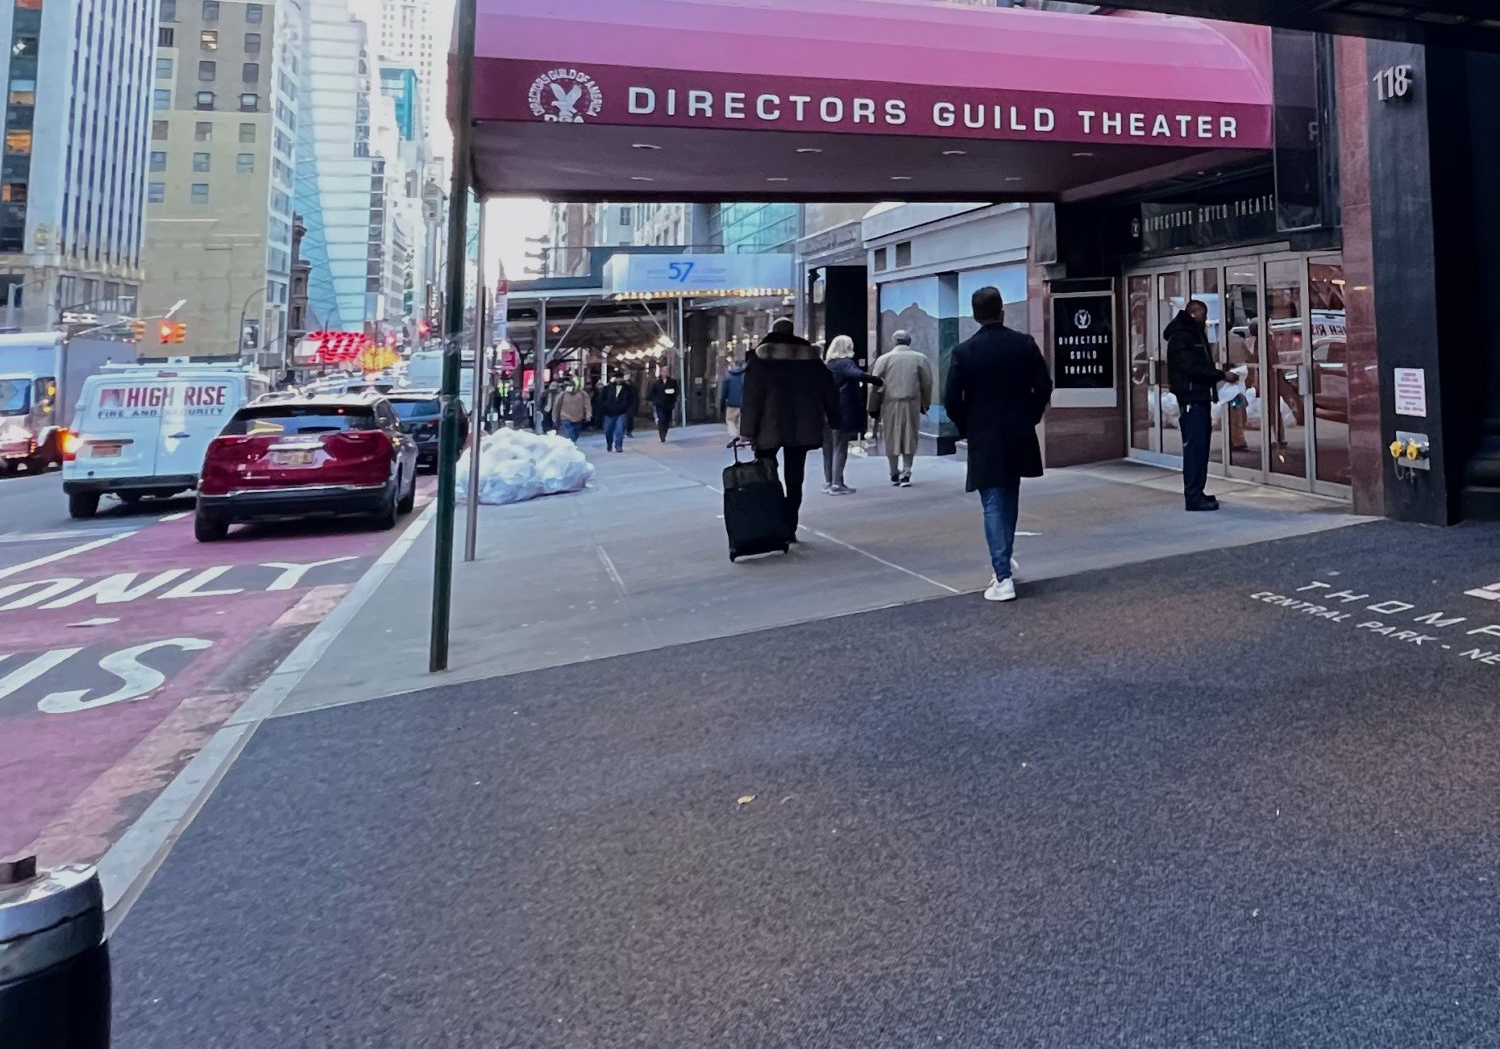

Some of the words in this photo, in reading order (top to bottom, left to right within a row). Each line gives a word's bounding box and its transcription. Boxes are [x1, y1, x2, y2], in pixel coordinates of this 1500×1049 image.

[1372, 64, 1410, 101] 118
[627, 87, 907, 126] DIRECTORS
[933, 102, 1055, 132] GUILD
[1078, 110, 1238, 139] THEATER
[1145, 210, 1192, 231] DIRECTORS
[1199, 203, 1227, 223] GUILD
[1235, 194, 1274, 217] THEATE
[668, 262, 694, 283] 57
[1058, 335, 1108, 345] DIRECTORS
[1070, 350, 1097, 360] GUILD
[1064, 365, 1103, 374] THEATER
[127, 387, 175, 407] HIGH
[184, 386, 227, 406] RISE
[132, 409, 157, 417] AND
[165, 407, 224, 416] URITY
[0, 556, 359, 611] ONLY
[1251, 592, 1351, 622] CENTRAL
[1355, 620, 1438, 645] PARK
